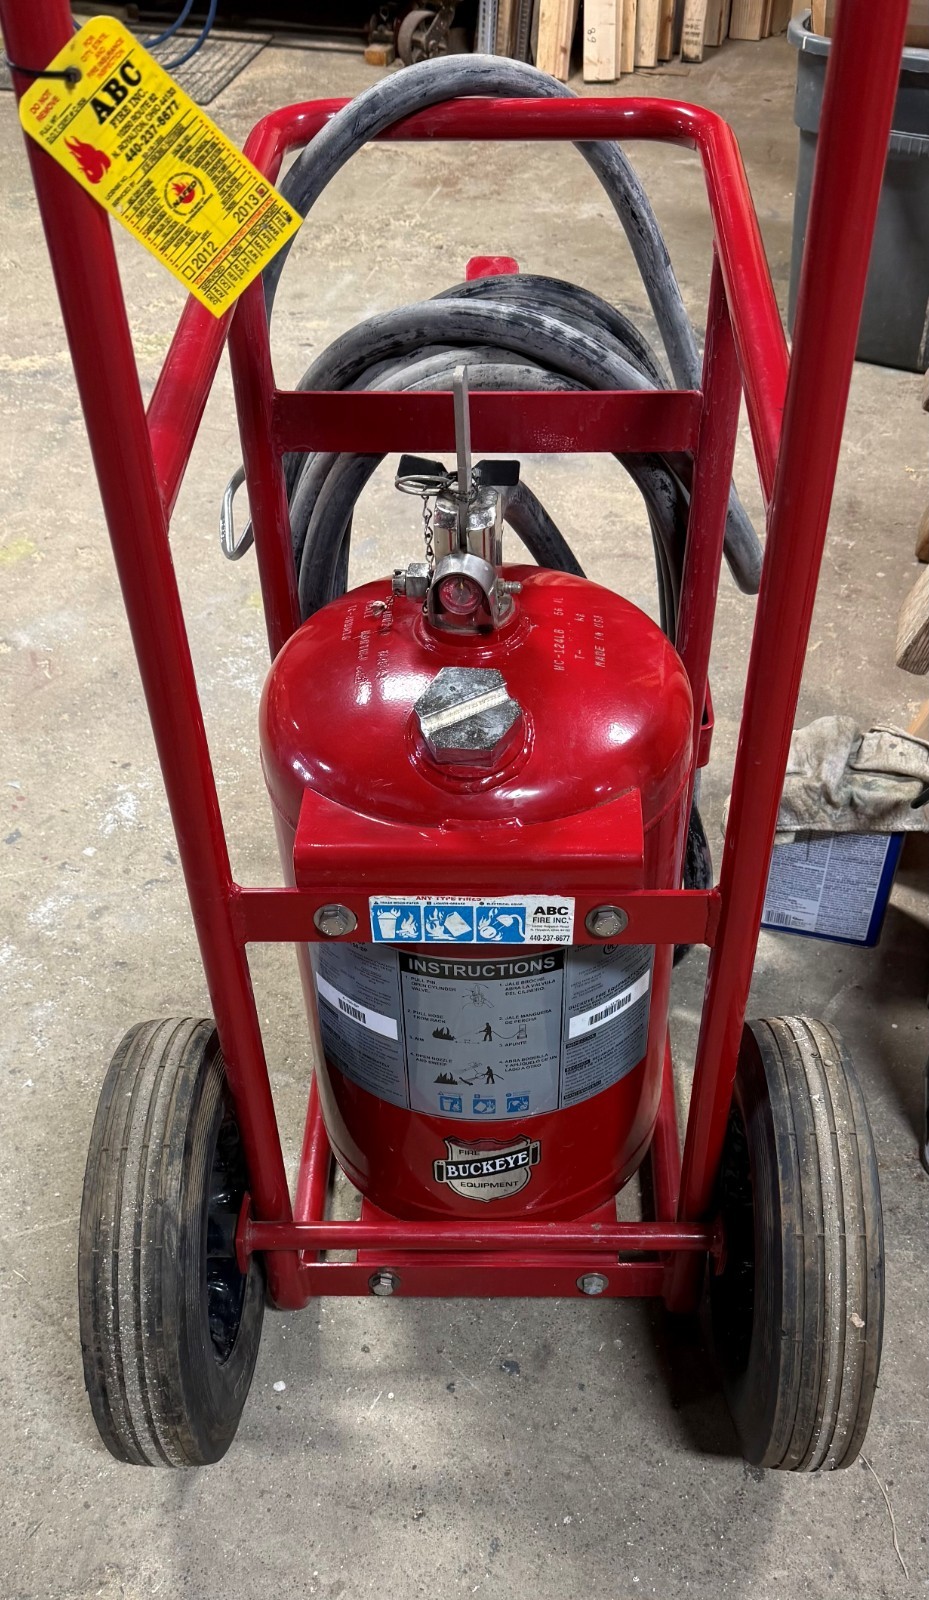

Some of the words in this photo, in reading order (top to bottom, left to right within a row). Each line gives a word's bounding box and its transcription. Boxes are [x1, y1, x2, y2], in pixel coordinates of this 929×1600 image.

[28, 102, 41, 115] DO
[36, 88, 52, 105] NOT
[82, 59, 146, 125] ABC
[35, 95, 60, 122] REMOVE
[108, 104, 132, 129] FIRE
[127, 85, 148, 108] INC.
[130, 100, 152, 123] ROUTE
[144, 102, 162, 121] OHIO
[122, 98, 182, 163] 440-237-6677
[230, 192, 261, 224] 2013
[247, 203, 280, 238] RECHARGED
[190, 239, 219, 270] 2012
[229, 243, 244, 259] NEW
[200, 264, 226, 292] SERVICED
[218, 277, 232, 290] OCT
[205, 292, 219, 305] DEC
[211, 285, 225, 298] NOV
[594, 644, 606, 668] MADE
[533, 906, 569, 915] ABC
[408, 957, 556, 977] INSTRUCTIONS
[427, 984, 457, 992] CYLINDER
[431, 1055, 453, 1064] NOZZLE
[446, 1151, 529, 1177] BUCKEYE
[460, 1181, 519, 1189] EQUIPMENT
